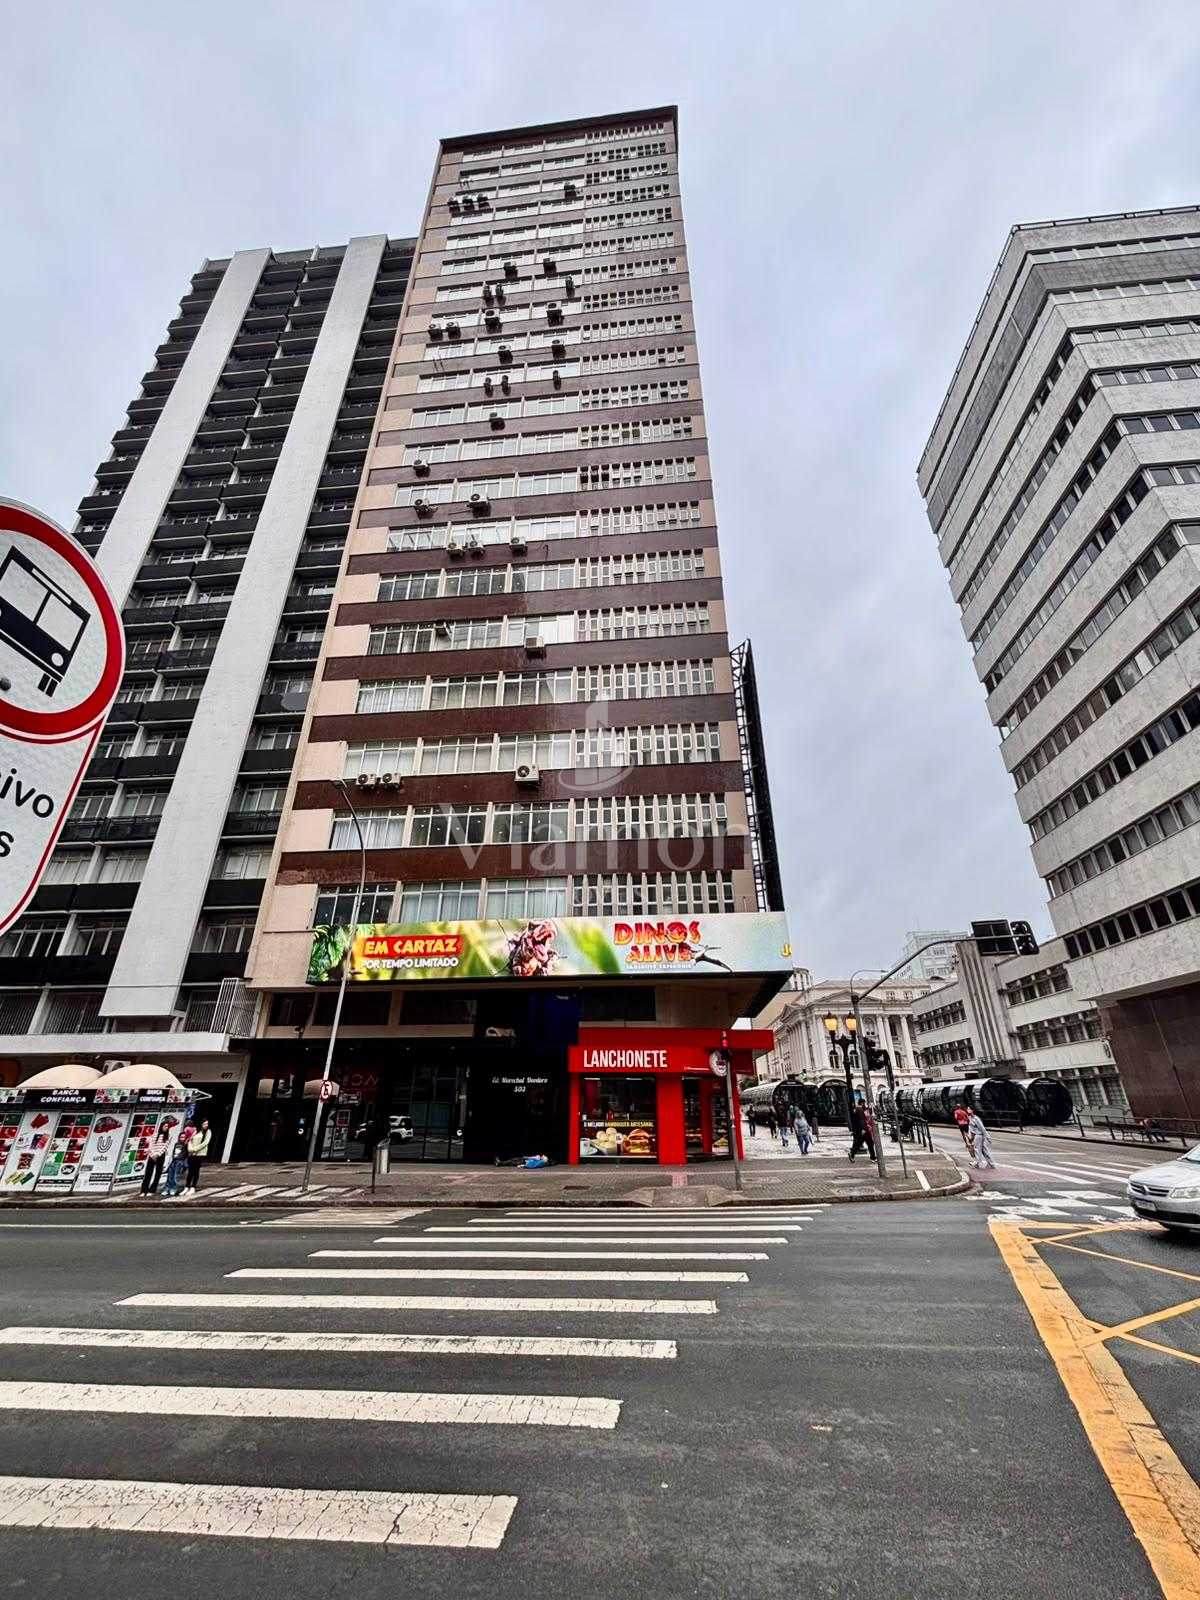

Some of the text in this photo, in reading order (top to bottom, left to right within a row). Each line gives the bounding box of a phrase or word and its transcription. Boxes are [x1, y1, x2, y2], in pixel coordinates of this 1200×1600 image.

[0, 768, 54, 818] ivo
[613, 921, 701, 945] DINOS
[364, 938, 457, 955] EM CARTAZ
[625, 944, 692, 964] ALIVE
[362, 957, 459, 969] POR TEMPO LIMITADO
[583, 1050, 668, 1068] LANCHONETE
